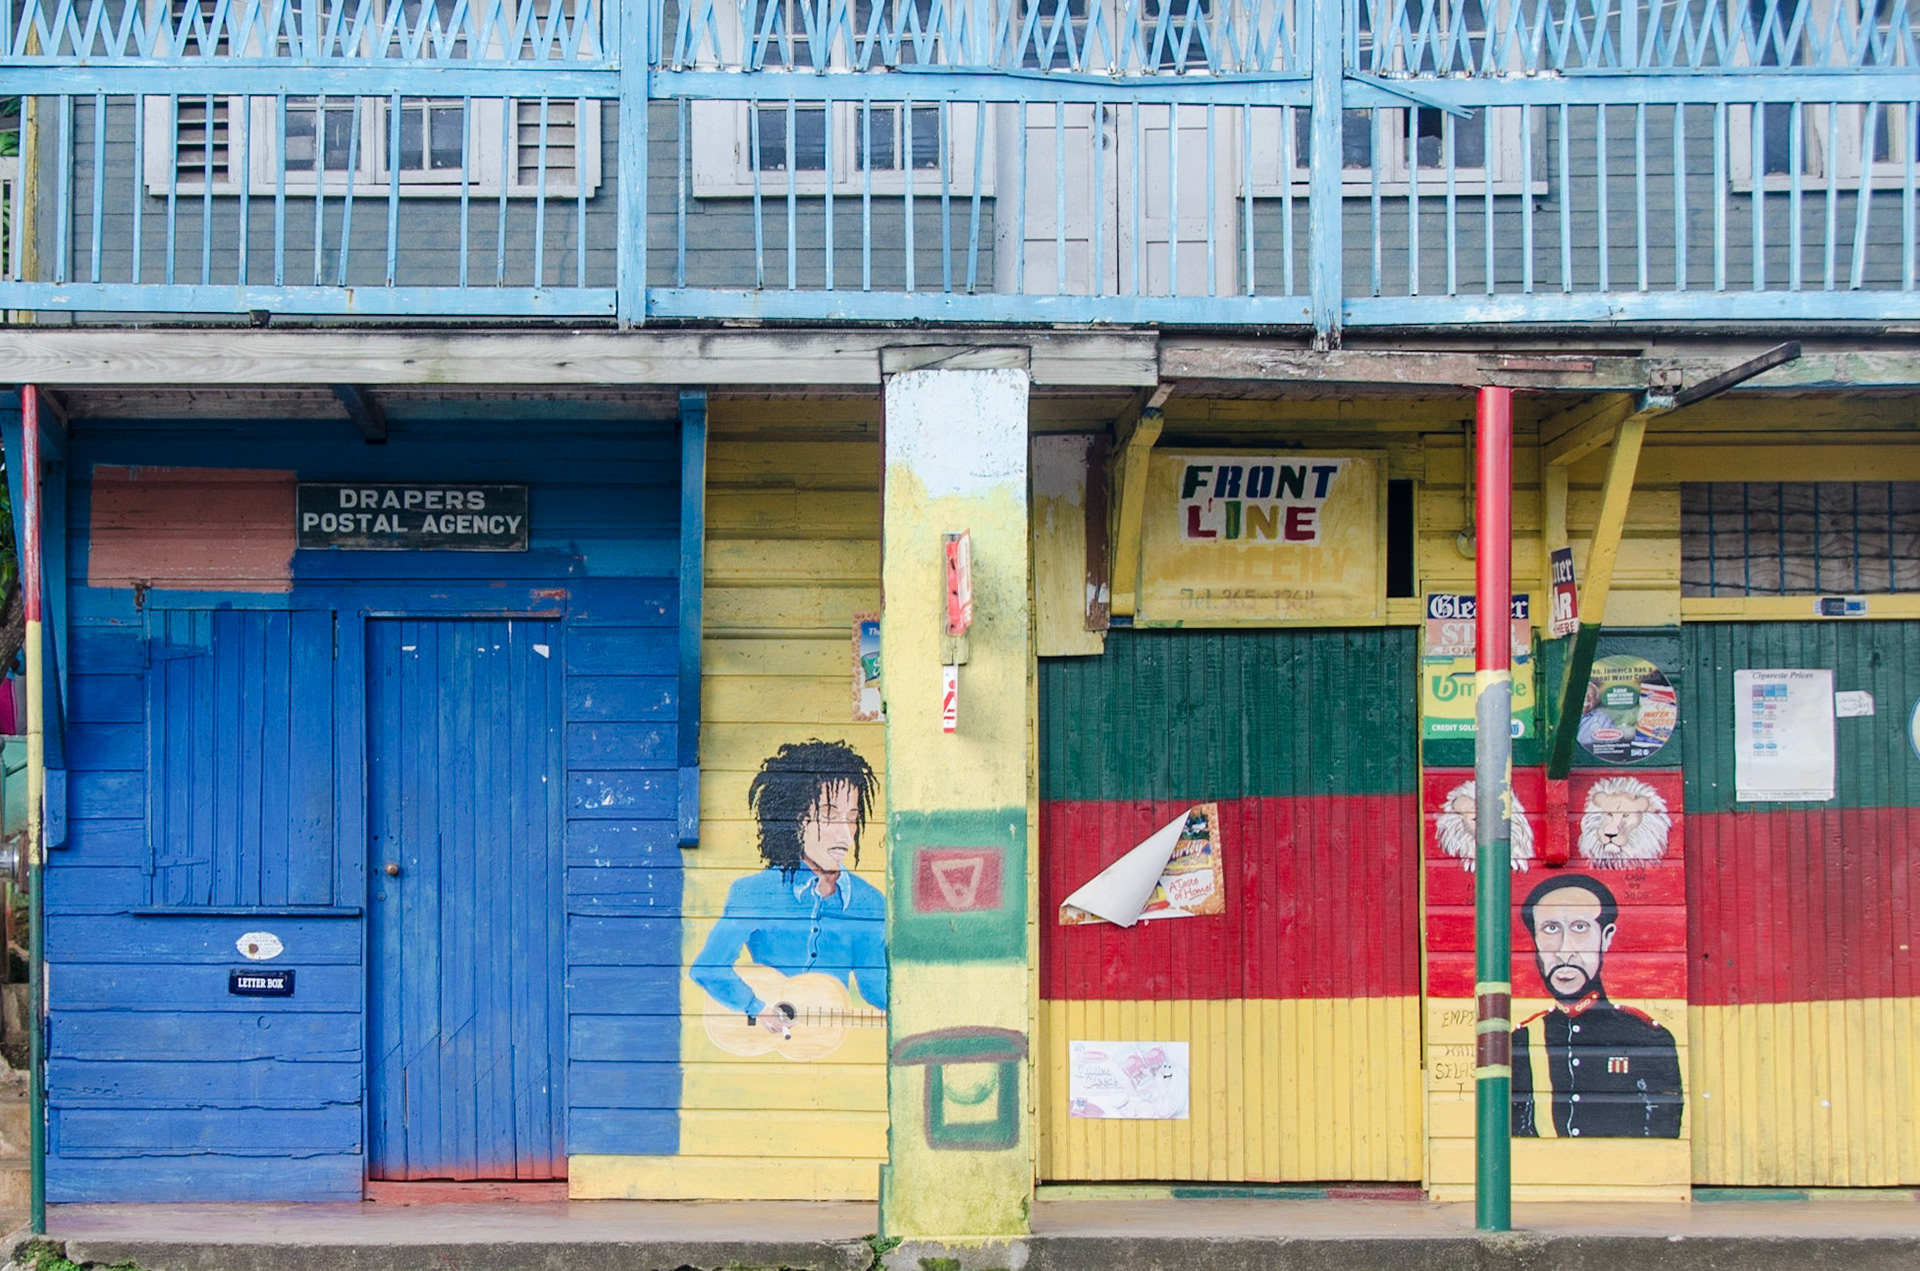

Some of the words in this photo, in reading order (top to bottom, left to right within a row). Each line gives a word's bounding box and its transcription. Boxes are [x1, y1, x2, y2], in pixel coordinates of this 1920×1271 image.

[1182, 465, 1338, 499] FRONT
[339, 489, 486, 510] DRAPERS
[303, 513, 408, 533] POSTAL
[421, 514, 522, 535] AGENCY
[1187, 501, 1316, 541] LINE
[1790, 671, 1814, 679] Prices
[1431, 724, 1458, 732] CREDIT
[1169, 881, 1176, 892] A
[1176, 877, 1199, 889] Taste
[1174, 892, 1182, 901] of
[238, 977, 266, 988] LETTER
[266, 978, 284, 989] BOX
